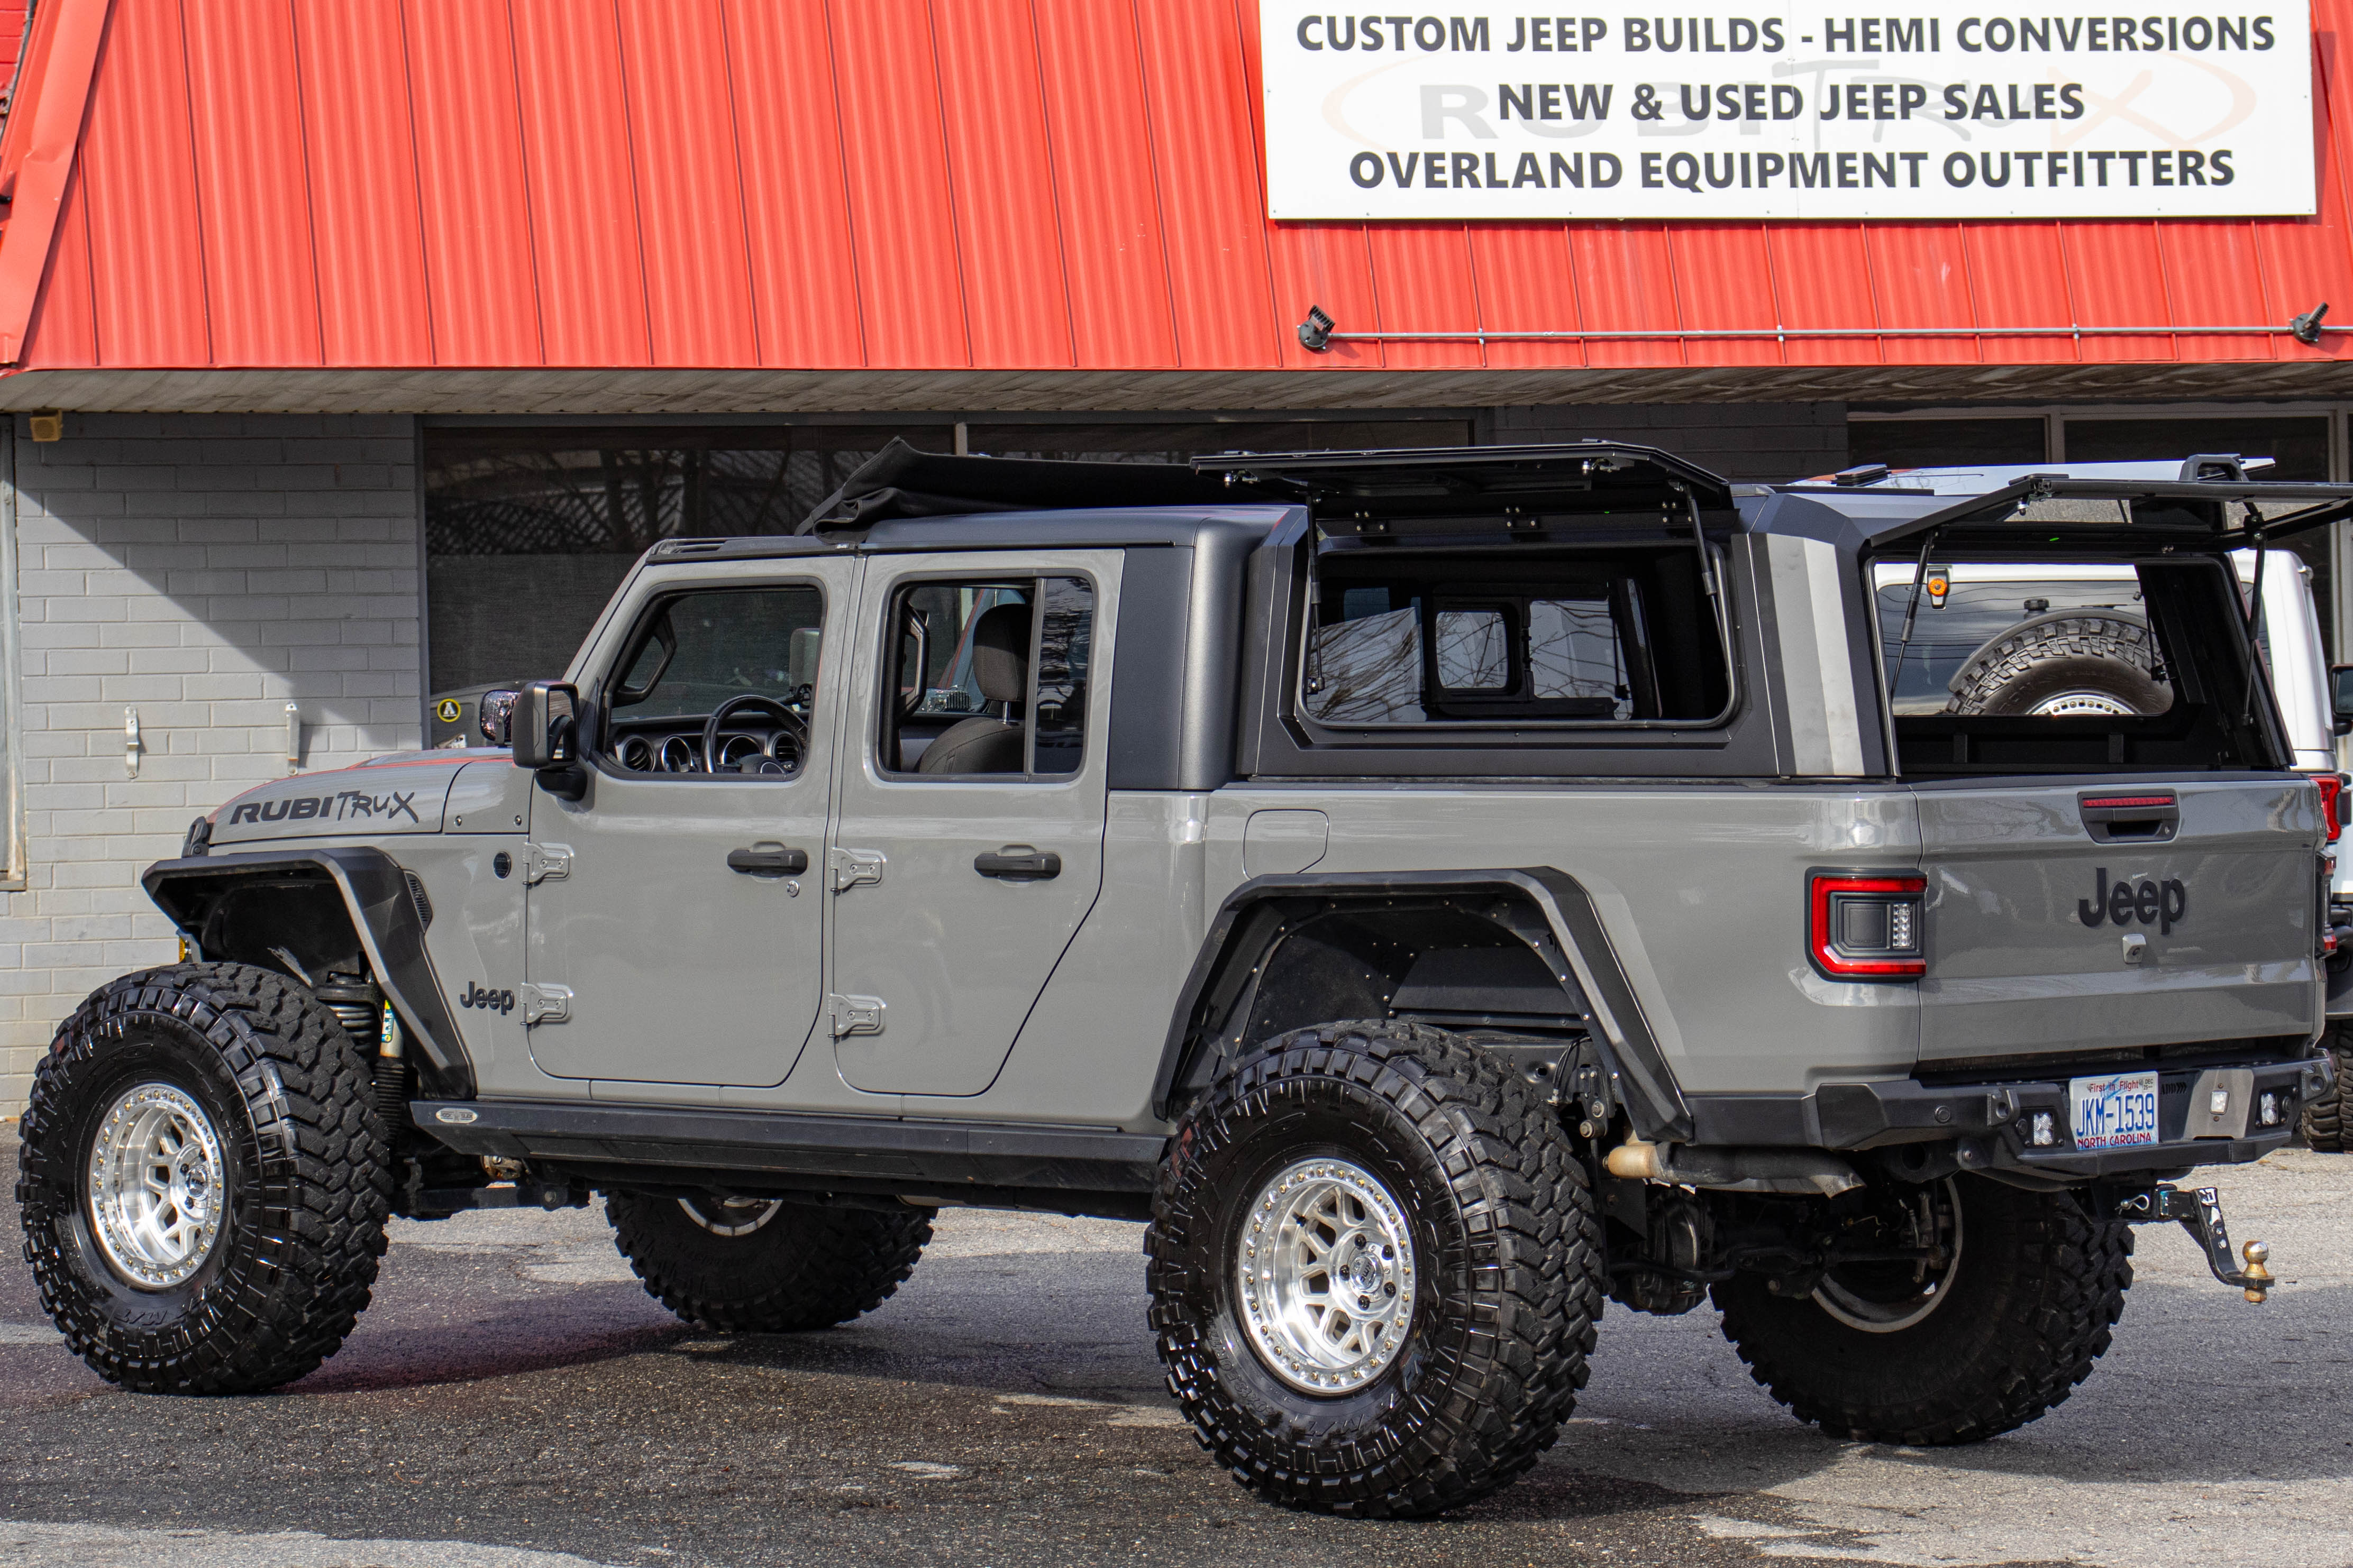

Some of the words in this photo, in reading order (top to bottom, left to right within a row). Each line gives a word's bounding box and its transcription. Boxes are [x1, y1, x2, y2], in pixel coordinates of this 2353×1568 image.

[1297, 15, 1490, 52] CUSTOM
[1506, 17, 1607, 52] JEEP
[1624, 18, 1785, 52] BUILDS
[1825, 18, 1940, 52] HEMI
[1956, 16, 2275, 52] CONVERSIONS
[1498, 84, 1613, 120] NEW
[1630, 84, 1665, 121] &
[1680, 84, 1803, 121] USED
[1819, 84, 1927, 121] JEEP
[1943, 83, 2084, 120] SALES
[1349, 151, 1622, 189] OVERLAND
[1640, 152, 1928, 194] EQUIPMENT
[1942, 150, 2235, 188] OUTFITTERS
[2077, 867, 2185, 935] Jeep
[460, 980, 515, 1016] Jeep
[2090, 1083, 2105, 1093] First
[2119, 1080, 2139, 1092] Flight
[2076, 1093, 2155, 1137] JKM-1539
[2077, 1135, 2106, 1149] NORTH
[2109, 1132, 2152, 1146] CAROLINA
